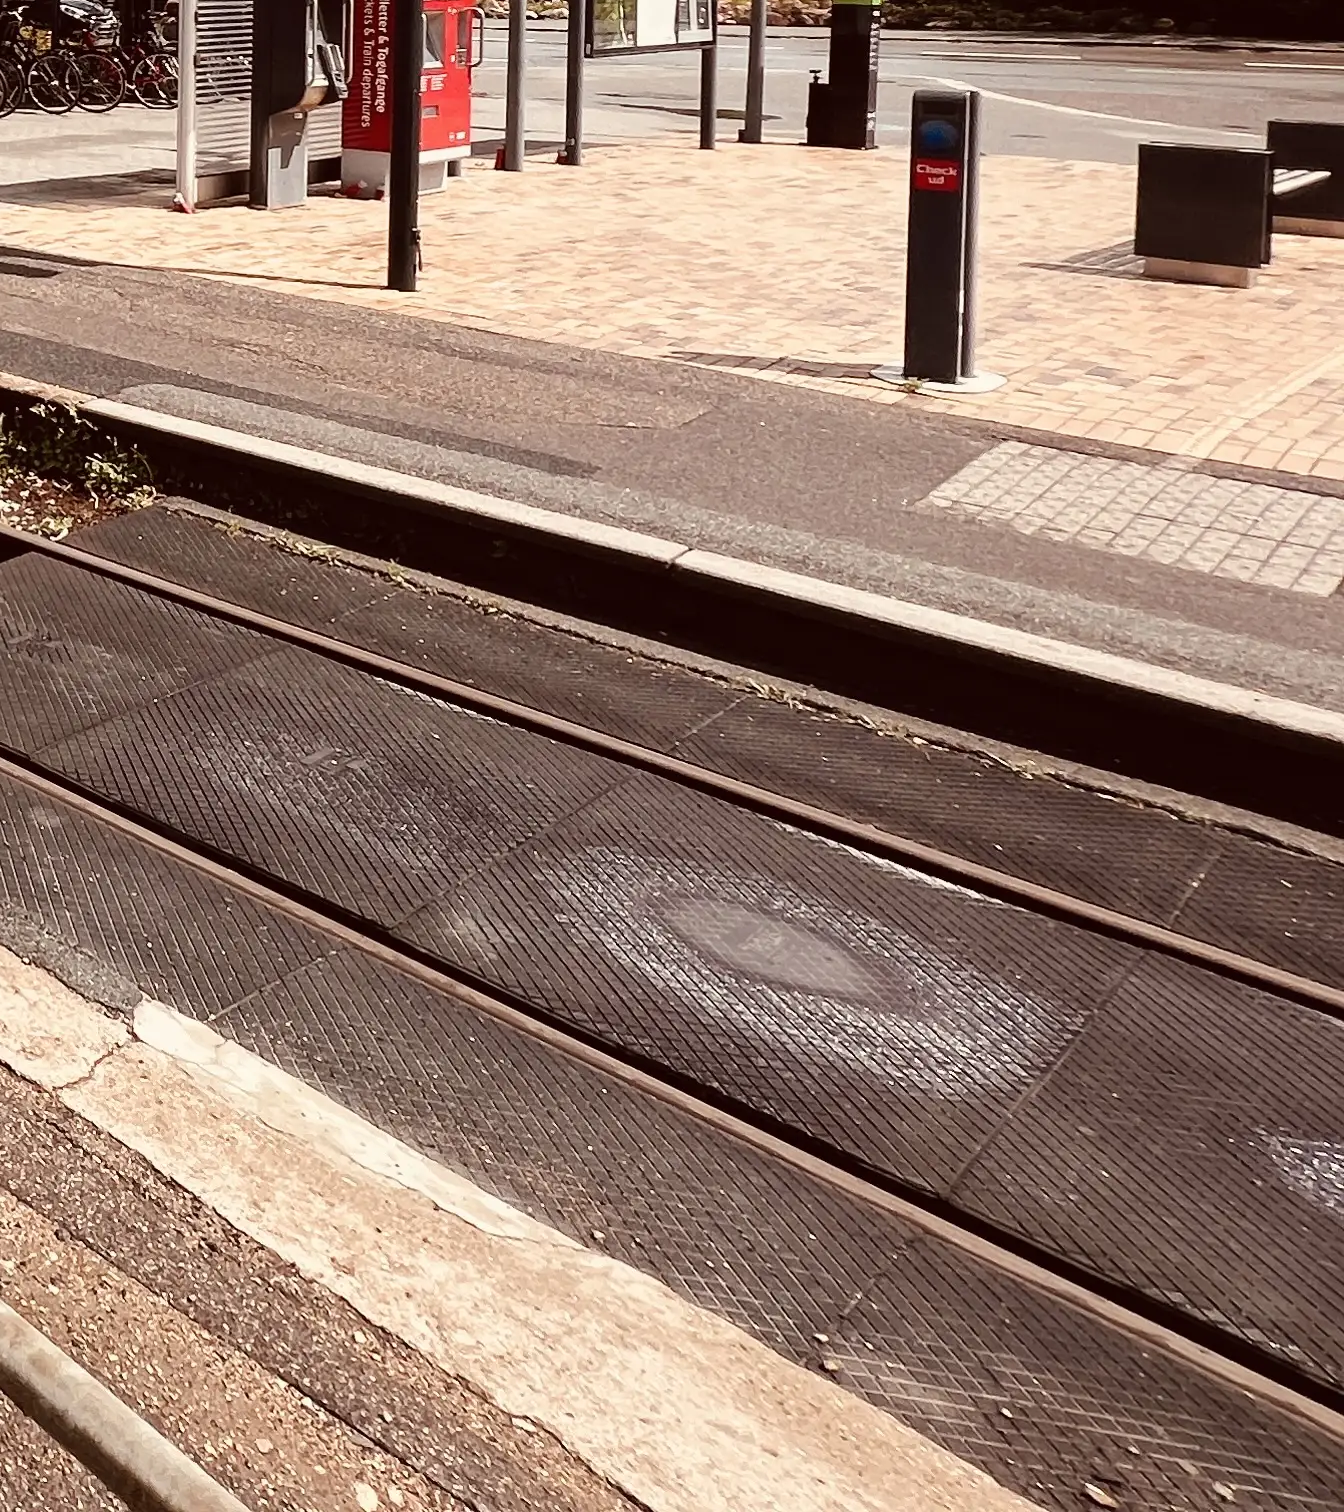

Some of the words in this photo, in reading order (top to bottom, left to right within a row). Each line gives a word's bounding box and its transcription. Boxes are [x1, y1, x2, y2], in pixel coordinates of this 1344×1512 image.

[363, 27, 376, 36] &
[377, 35, 390, 45] &
[362, 39, 376, 66] Train
[374, 46, 390, 113] Togafgange
[360, 68, 375, 128] departures
[916, 163, 958, 176] Check
[927, 175, 945, 185] ud
